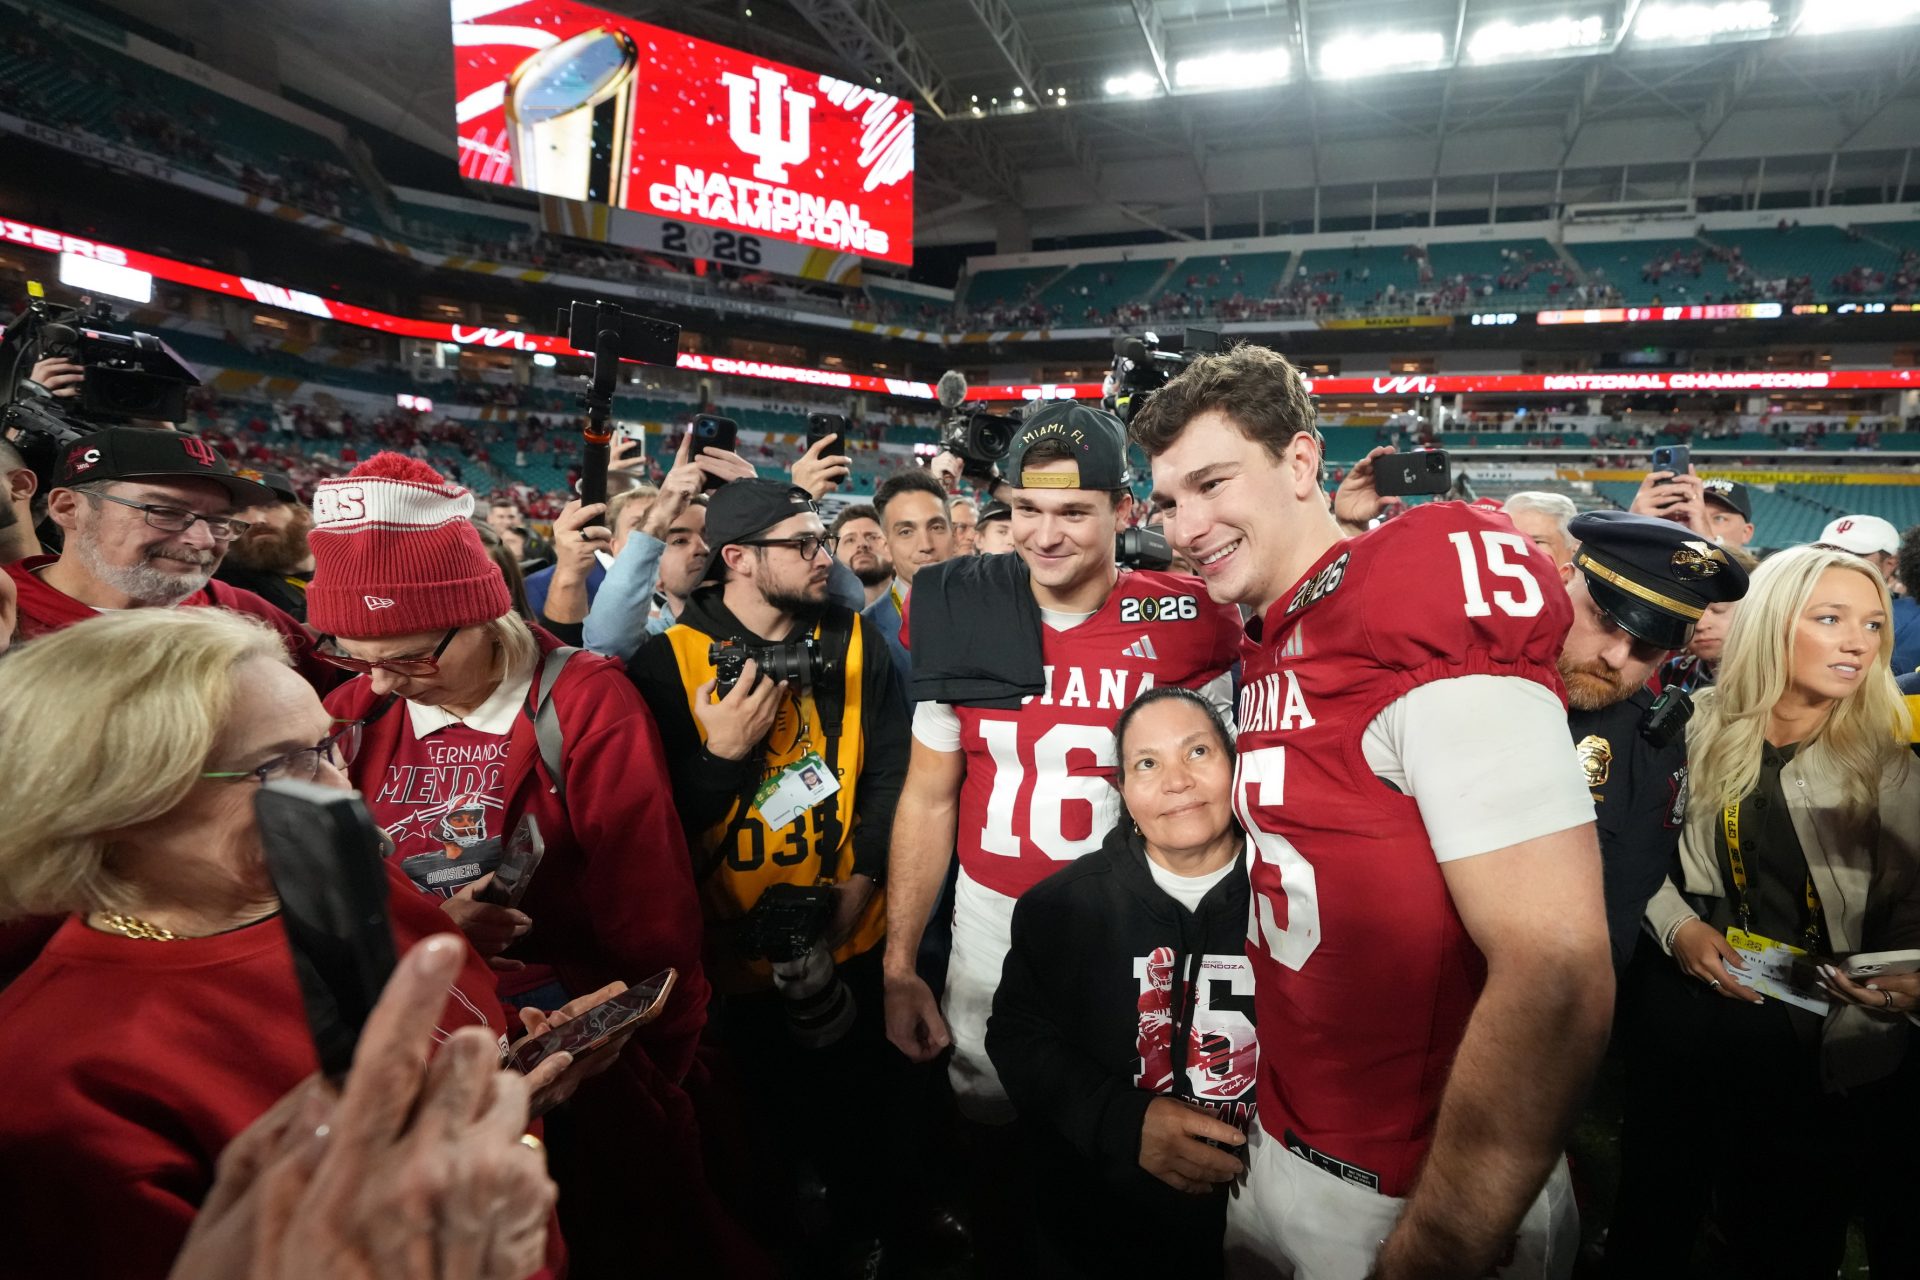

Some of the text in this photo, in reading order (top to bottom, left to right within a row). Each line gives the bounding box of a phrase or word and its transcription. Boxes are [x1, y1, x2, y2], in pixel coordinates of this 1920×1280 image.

[649, 182, 889, 255] CHAMPIONS
[675, 164, 870, 231] NATIONAL
[0, 220, 127, 266] IERS
[713, 357, 851, 387] CHAMPIONS
[1544, 373, 1828, 389] NATIONAL CHAMPIONS
[1022, 423, 1084, 445] MIAMI, FL
[1448, 531, 1544, 617] 15
[1021, 665, 1154, 710] IANA
[1238, 669, 1316, 735] DIANA
[376, 763, 504, 804] MENDO
[979, 719, 1122, 861] 16
[426, 863, 482, 885] HOOSIERS
